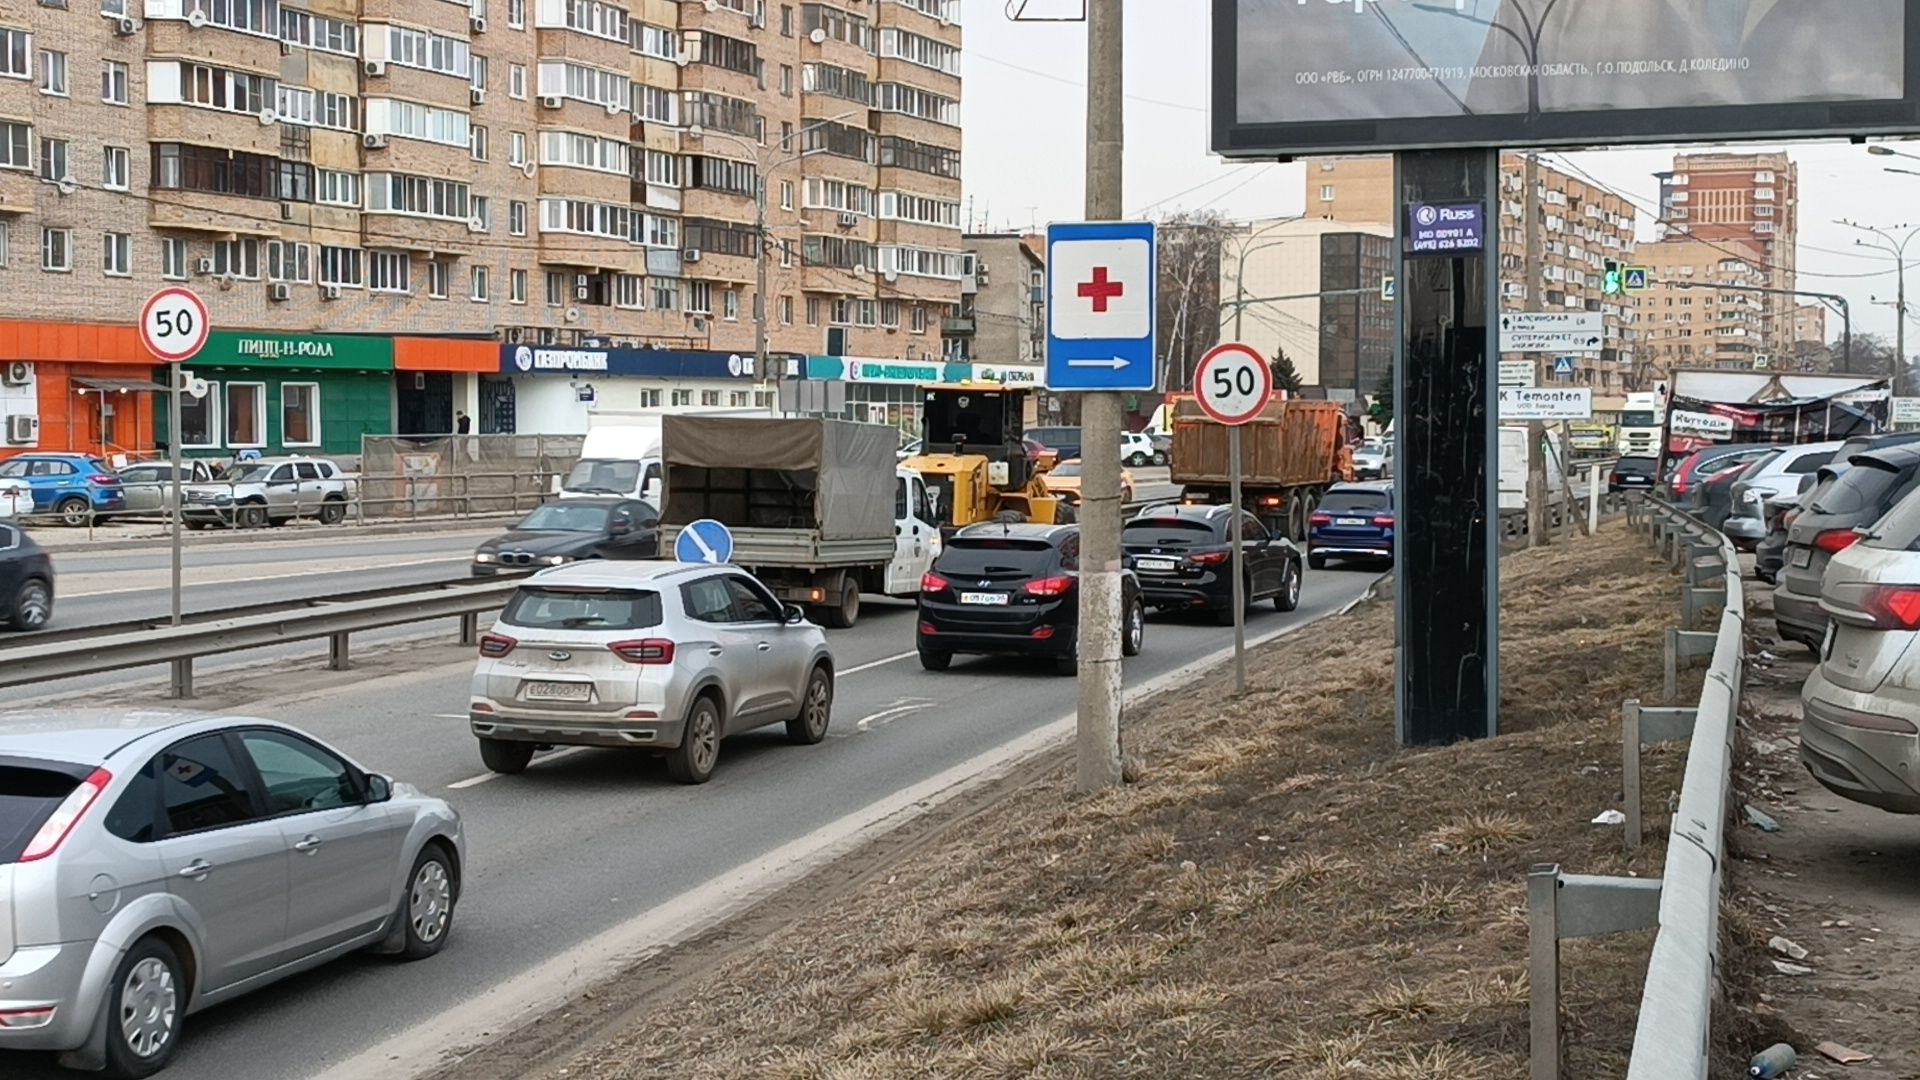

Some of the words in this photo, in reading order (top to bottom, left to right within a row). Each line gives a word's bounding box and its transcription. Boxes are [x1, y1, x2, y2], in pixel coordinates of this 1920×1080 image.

[1295, 72, 1318, 85] ООО
[1357, 69, 1383, 82] ОГРН
[1469, 64, 1539, 79] МОСКОВСКАЯ
[1440, 208, 1475, 221] Russ
[156, 309, 193, 337] 50
[1214, 366, 1255, 398] 50
